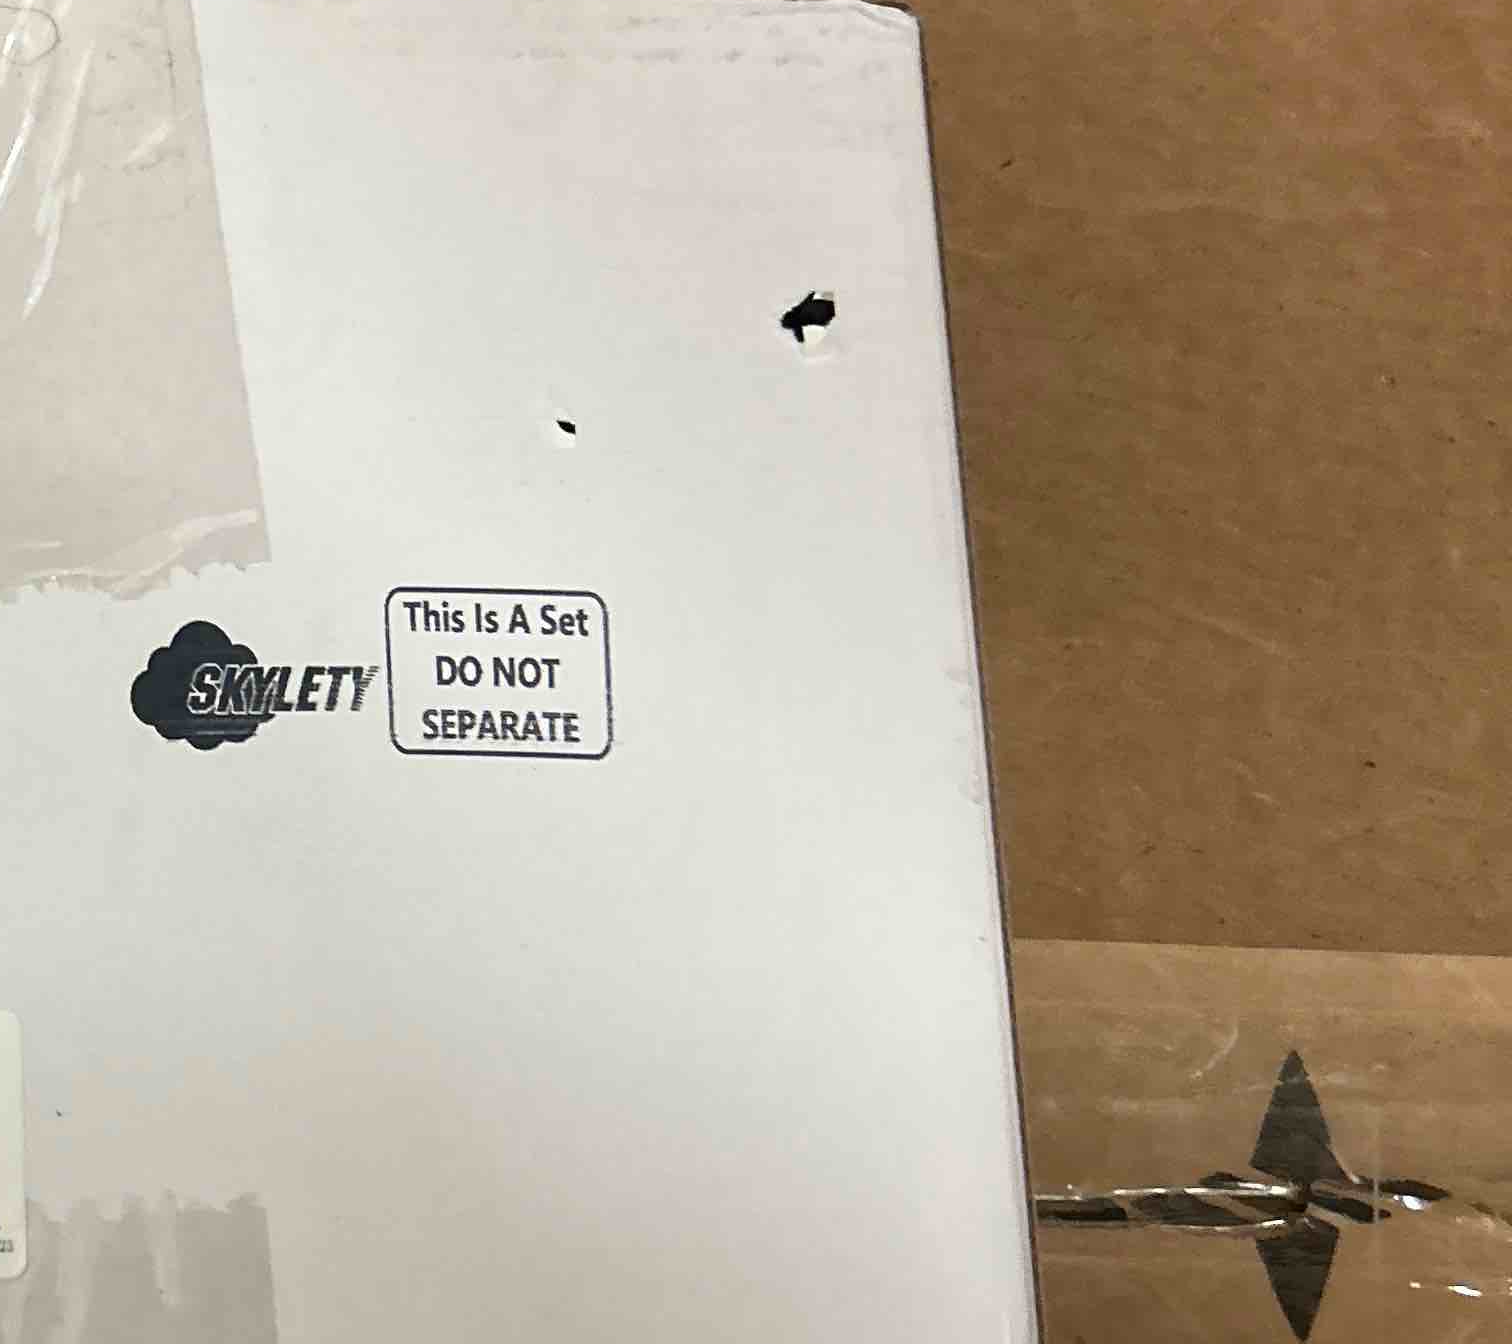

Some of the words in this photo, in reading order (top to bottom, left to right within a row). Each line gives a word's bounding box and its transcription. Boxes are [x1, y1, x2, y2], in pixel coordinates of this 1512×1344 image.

[403, 601, 465, 634] This
[475, 602, 499, 634] Is
[508, 603, 531, 635] A
[540, 603, 589, 637] Set
[188, 663, 379, 715] SKYLETY
[436, 655, 482, 687] DO
[493, 656, 560, 689] NOT
[422, 709, 581, 743] SEPARATE
